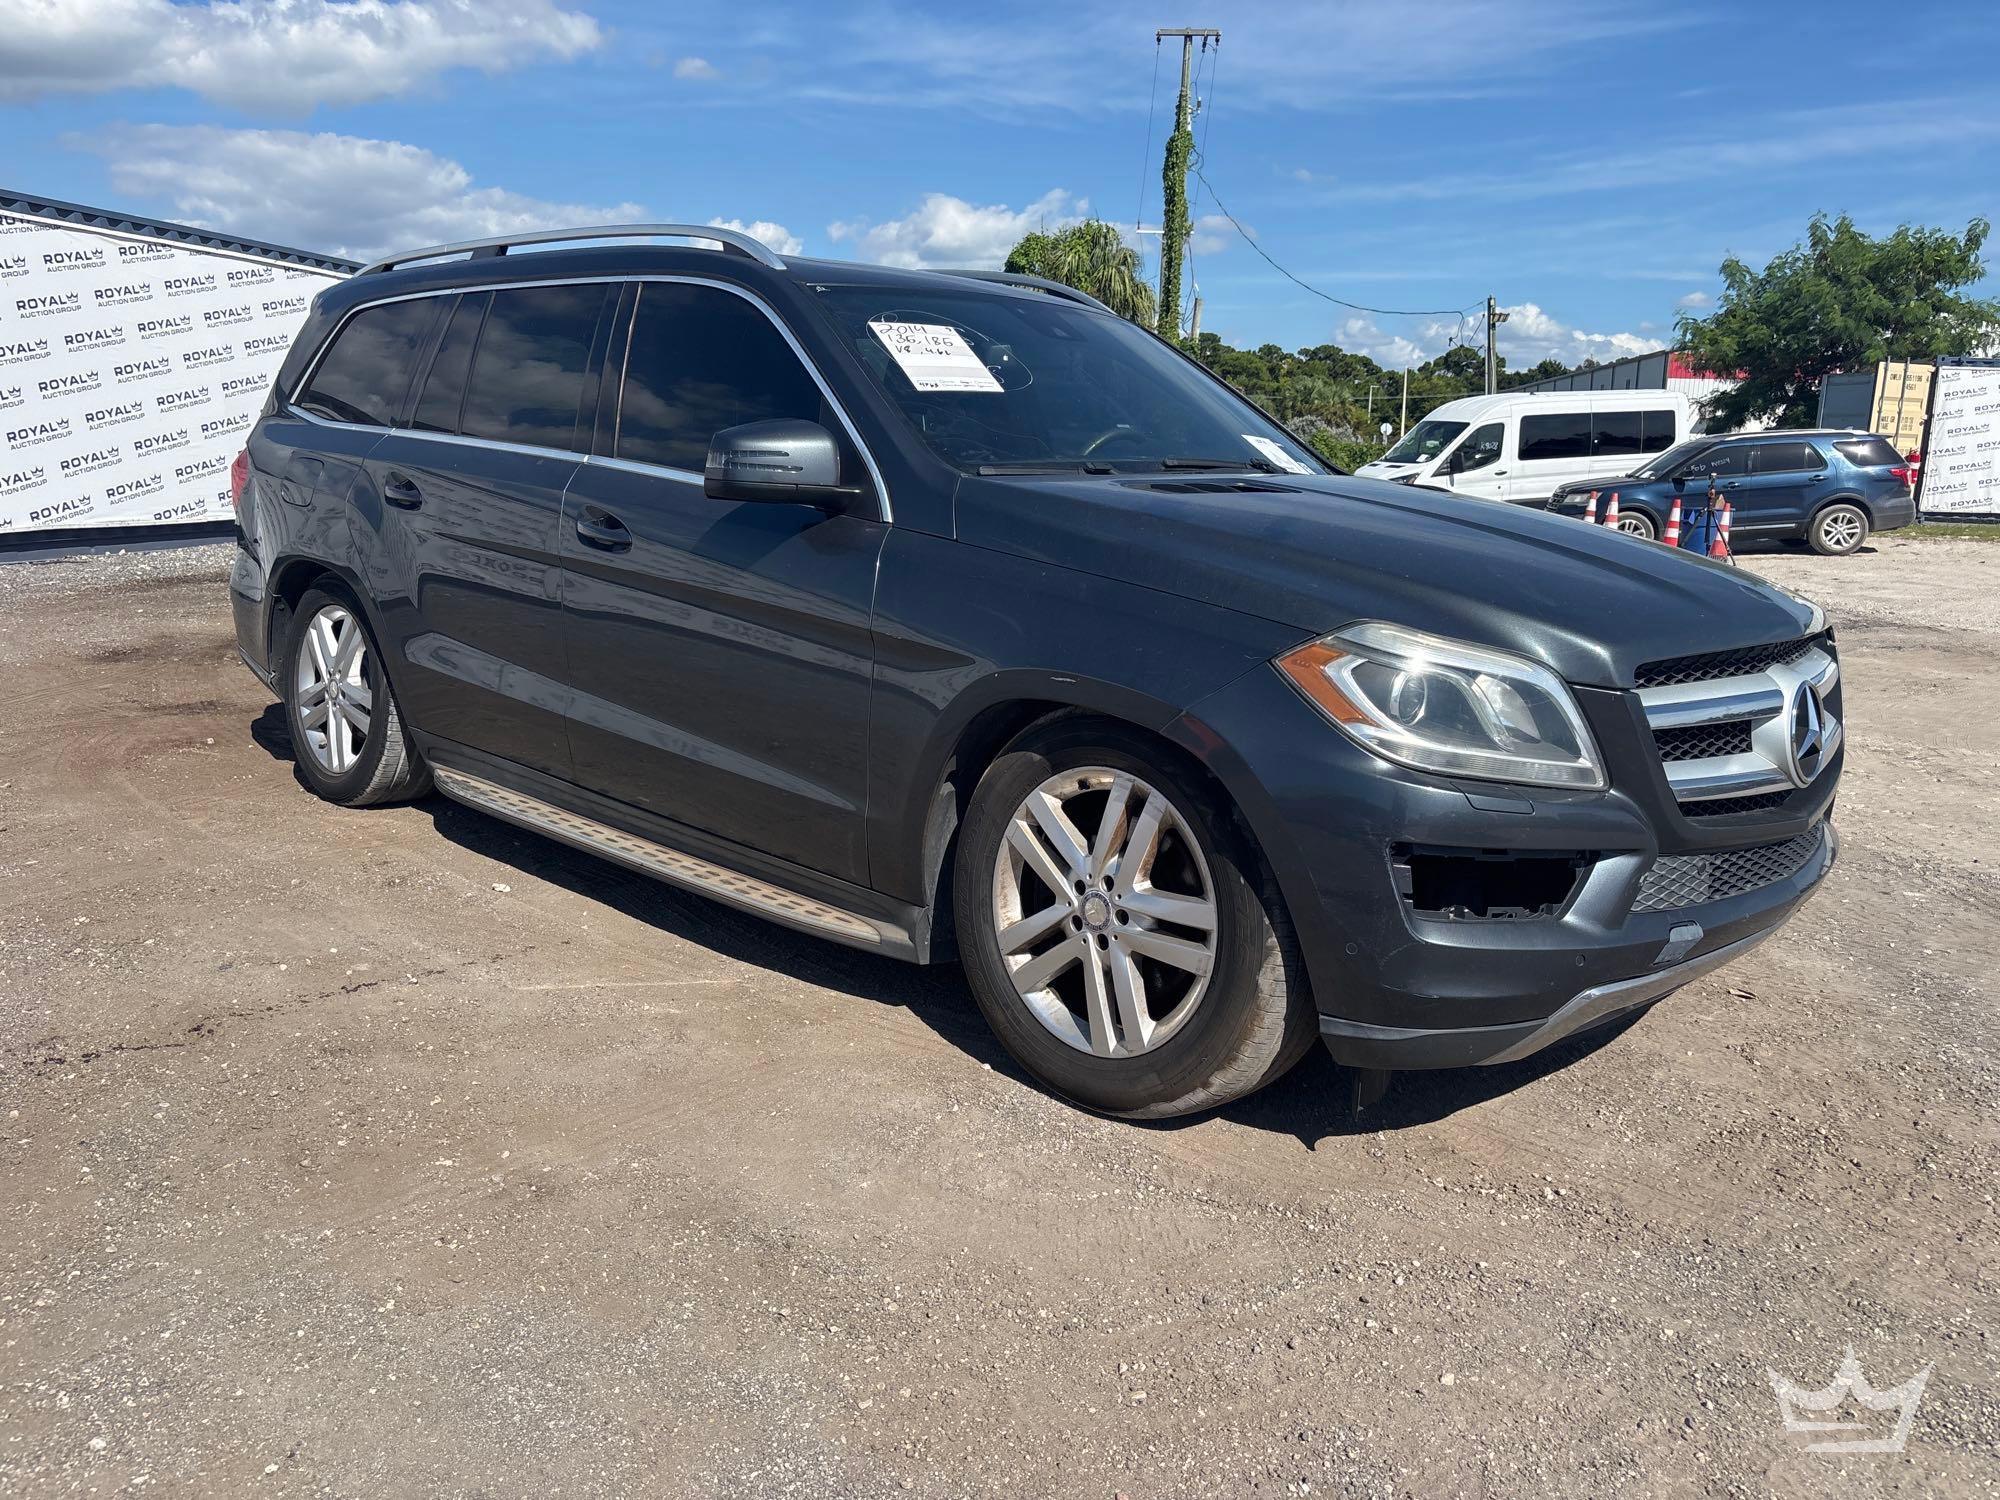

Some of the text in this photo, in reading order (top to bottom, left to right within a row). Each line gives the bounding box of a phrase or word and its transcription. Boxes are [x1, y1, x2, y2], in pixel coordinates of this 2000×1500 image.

[43, 250, 93, 265] ROYAL
[118, 243, 162, 257] ROYAL
[47, 261, 107, 273] AUCTION GROUP
[122, 253, 176, 265] AUCTION GROUP
[1, 269, 30, 279] GROUP
[227, 268, 264, 281] ROYAL
[164, 275, 206, 290] ROYAL
[230, 277, 275, 288] AUCTION GROUP
[94, 284, 141, 300] ROYAL
[167, 285, 218, 298] AUCTION GROUP
[16, 294, 68, 311] ROYAL
[97, 294, 154, 308] AUCTION GROUP
[262, 298, 298, 312] ROYAL
[20, 304, 82, 319] AUCTION GROUP
[203, 307, 242, 322] ROYAL
[265, 306, 308, 319] AUCTION GROUP
[137, 317, 181, 333] ROYAL
[206, 315, 254, 329] AUCTION GROUP
[877, 324, 928, 334] 2014
[64, 328, 112, 346] ROYAL
[141, 326, 194, 340] AUCTION GROUP
[0, 342, 36, 358] OYAL
[68, 338, 127, 353] AUCTION GROUP
[244, 336, 280, 351] ROYAL
[247, 343, 291, 357] AUCTION GROUP
[0, 351, 52, 366] CTION GROUP
[182, 347, 224, 363] ROYAL
[185, 355, 235, 370] AUCTION GROUP
[113, 359, 159, 377] ROYAL
[38, 374, 88, 393] ROYAL
[117, 368, 172, 385] AUCTION GROUP
[221, 375, 259, 392] ROYAL
[42, 382, 102, 400] AUCTION GROUP
[156, 389, 200, 407] ROYAL
[224, 383, 270, 399] AUCTION GROUP
[1944, 388, 1978, 398] ROYAL
[159, 397, 212, 415] AUCTION GROUP
[1975, 403, 2000, 412] ROYA
[85, 405, 132, 424] ROYAL
[88, 413, 146, 432] AUCTION GROUP
[6, 421, 58, 443] ROYAL
[201, 415, 242, 434] ROYAL
[204, 423, 252, 440] AUCTION GROUP
[1947, 425, 1981, 435] ROYAL
[10, 430, 73, 451] AUCTION GROUP
[134, 432, 178, 451] ROYAL
[137, 439, 191, 458] AUCTION GROUP
[60, 450, 109, 471] ROYAL
[64, 457, 123, 479] AUCTION GROUP
[175, 459, 217, 478] ROYAL
[1949, 462, 1983, 471] ROYAL
[0, 471, 32, 488] YAL
[178, 465, 229, 485] AUCTION GROUP
[0, 478, 48, 497] TION GROUP
[106, 477, 152, 499] ROYAL
[109, 484, 165, 506] AUCTION GROUP
[29, 499, 80, 522] ROYAL
[153, 502, 196, 520] ROYAL
[1950, 499, 1984, 508] ROYAL
[68, 506, 95, 519] GROUP
